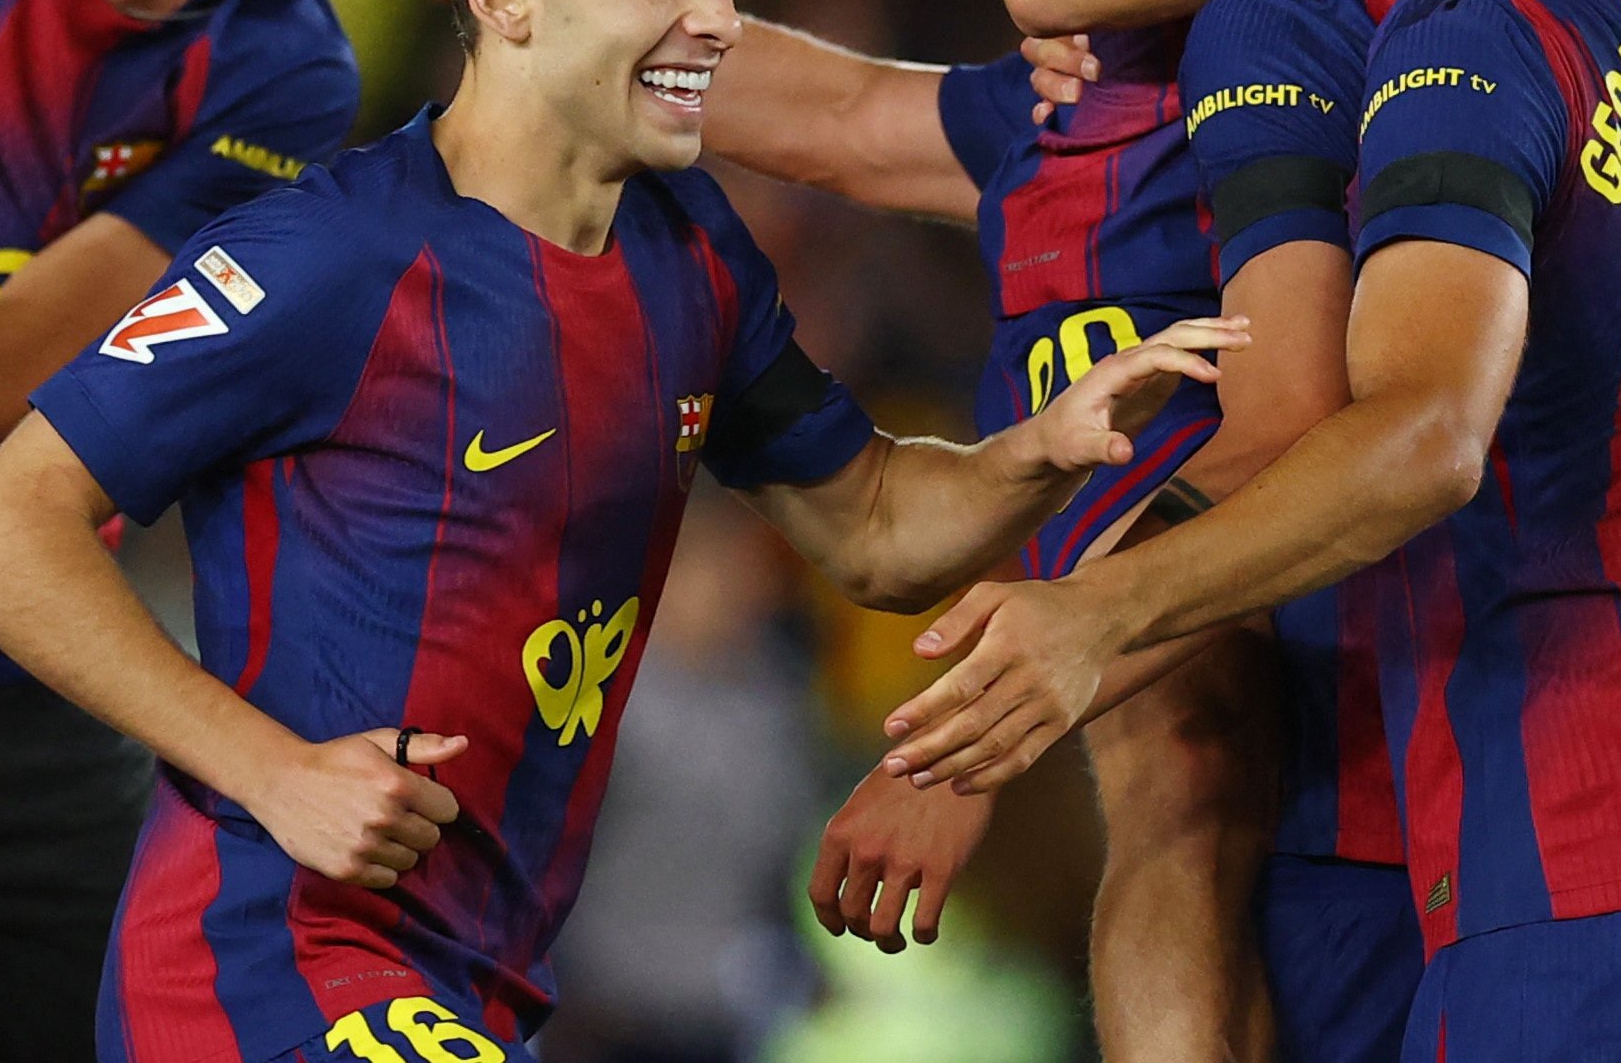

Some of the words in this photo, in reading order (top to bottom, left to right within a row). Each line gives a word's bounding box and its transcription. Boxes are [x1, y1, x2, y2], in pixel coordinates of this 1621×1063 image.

[1185, 85, 1303, 140] AMBILIGHT
[1308, 93, 1335, 115] tv
[1359, 68, 1464, 144] AMBILIGHT
[1470, 74, 1496, 94] tv
[325, 996, 506, 1063] 16
